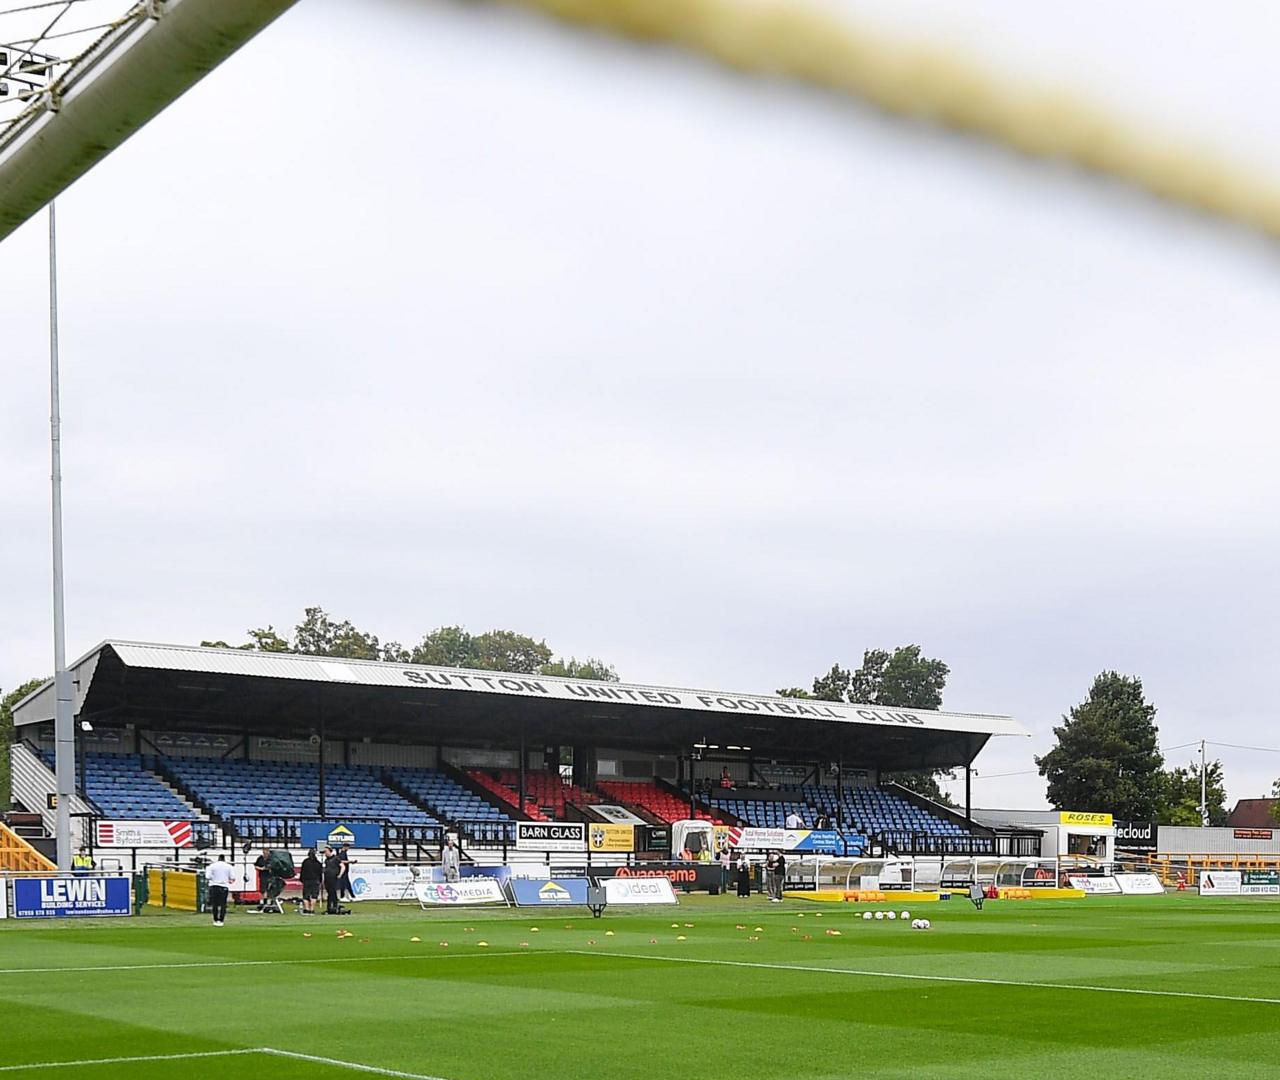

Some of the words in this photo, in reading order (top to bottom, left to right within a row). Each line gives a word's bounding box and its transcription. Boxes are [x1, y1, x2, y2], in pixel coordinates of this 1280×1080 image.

[403, 670, 547, 694] SUTTON
[565, 684, 682, 705] UNITED
[696, 696, 847, 719] FOOTBALL
[856, 710, 925, 725] CLUB
[1068, 813, 1106, 822] ROSES
[521, 827, 548, 838] BARN
[550, 827, 581, 839] GLASS
[116, 837, 141, 845] Byford
[630, 869, 696, 881] vanarama
[41, 879, 106, 902] LEWIN
[460, 889, 493, 897] MEDIA
[629, 882, 661, 894] Ideal
[41, 901, 74, 909] BUILDING
[75, 900, 106, 908] SERVICES
